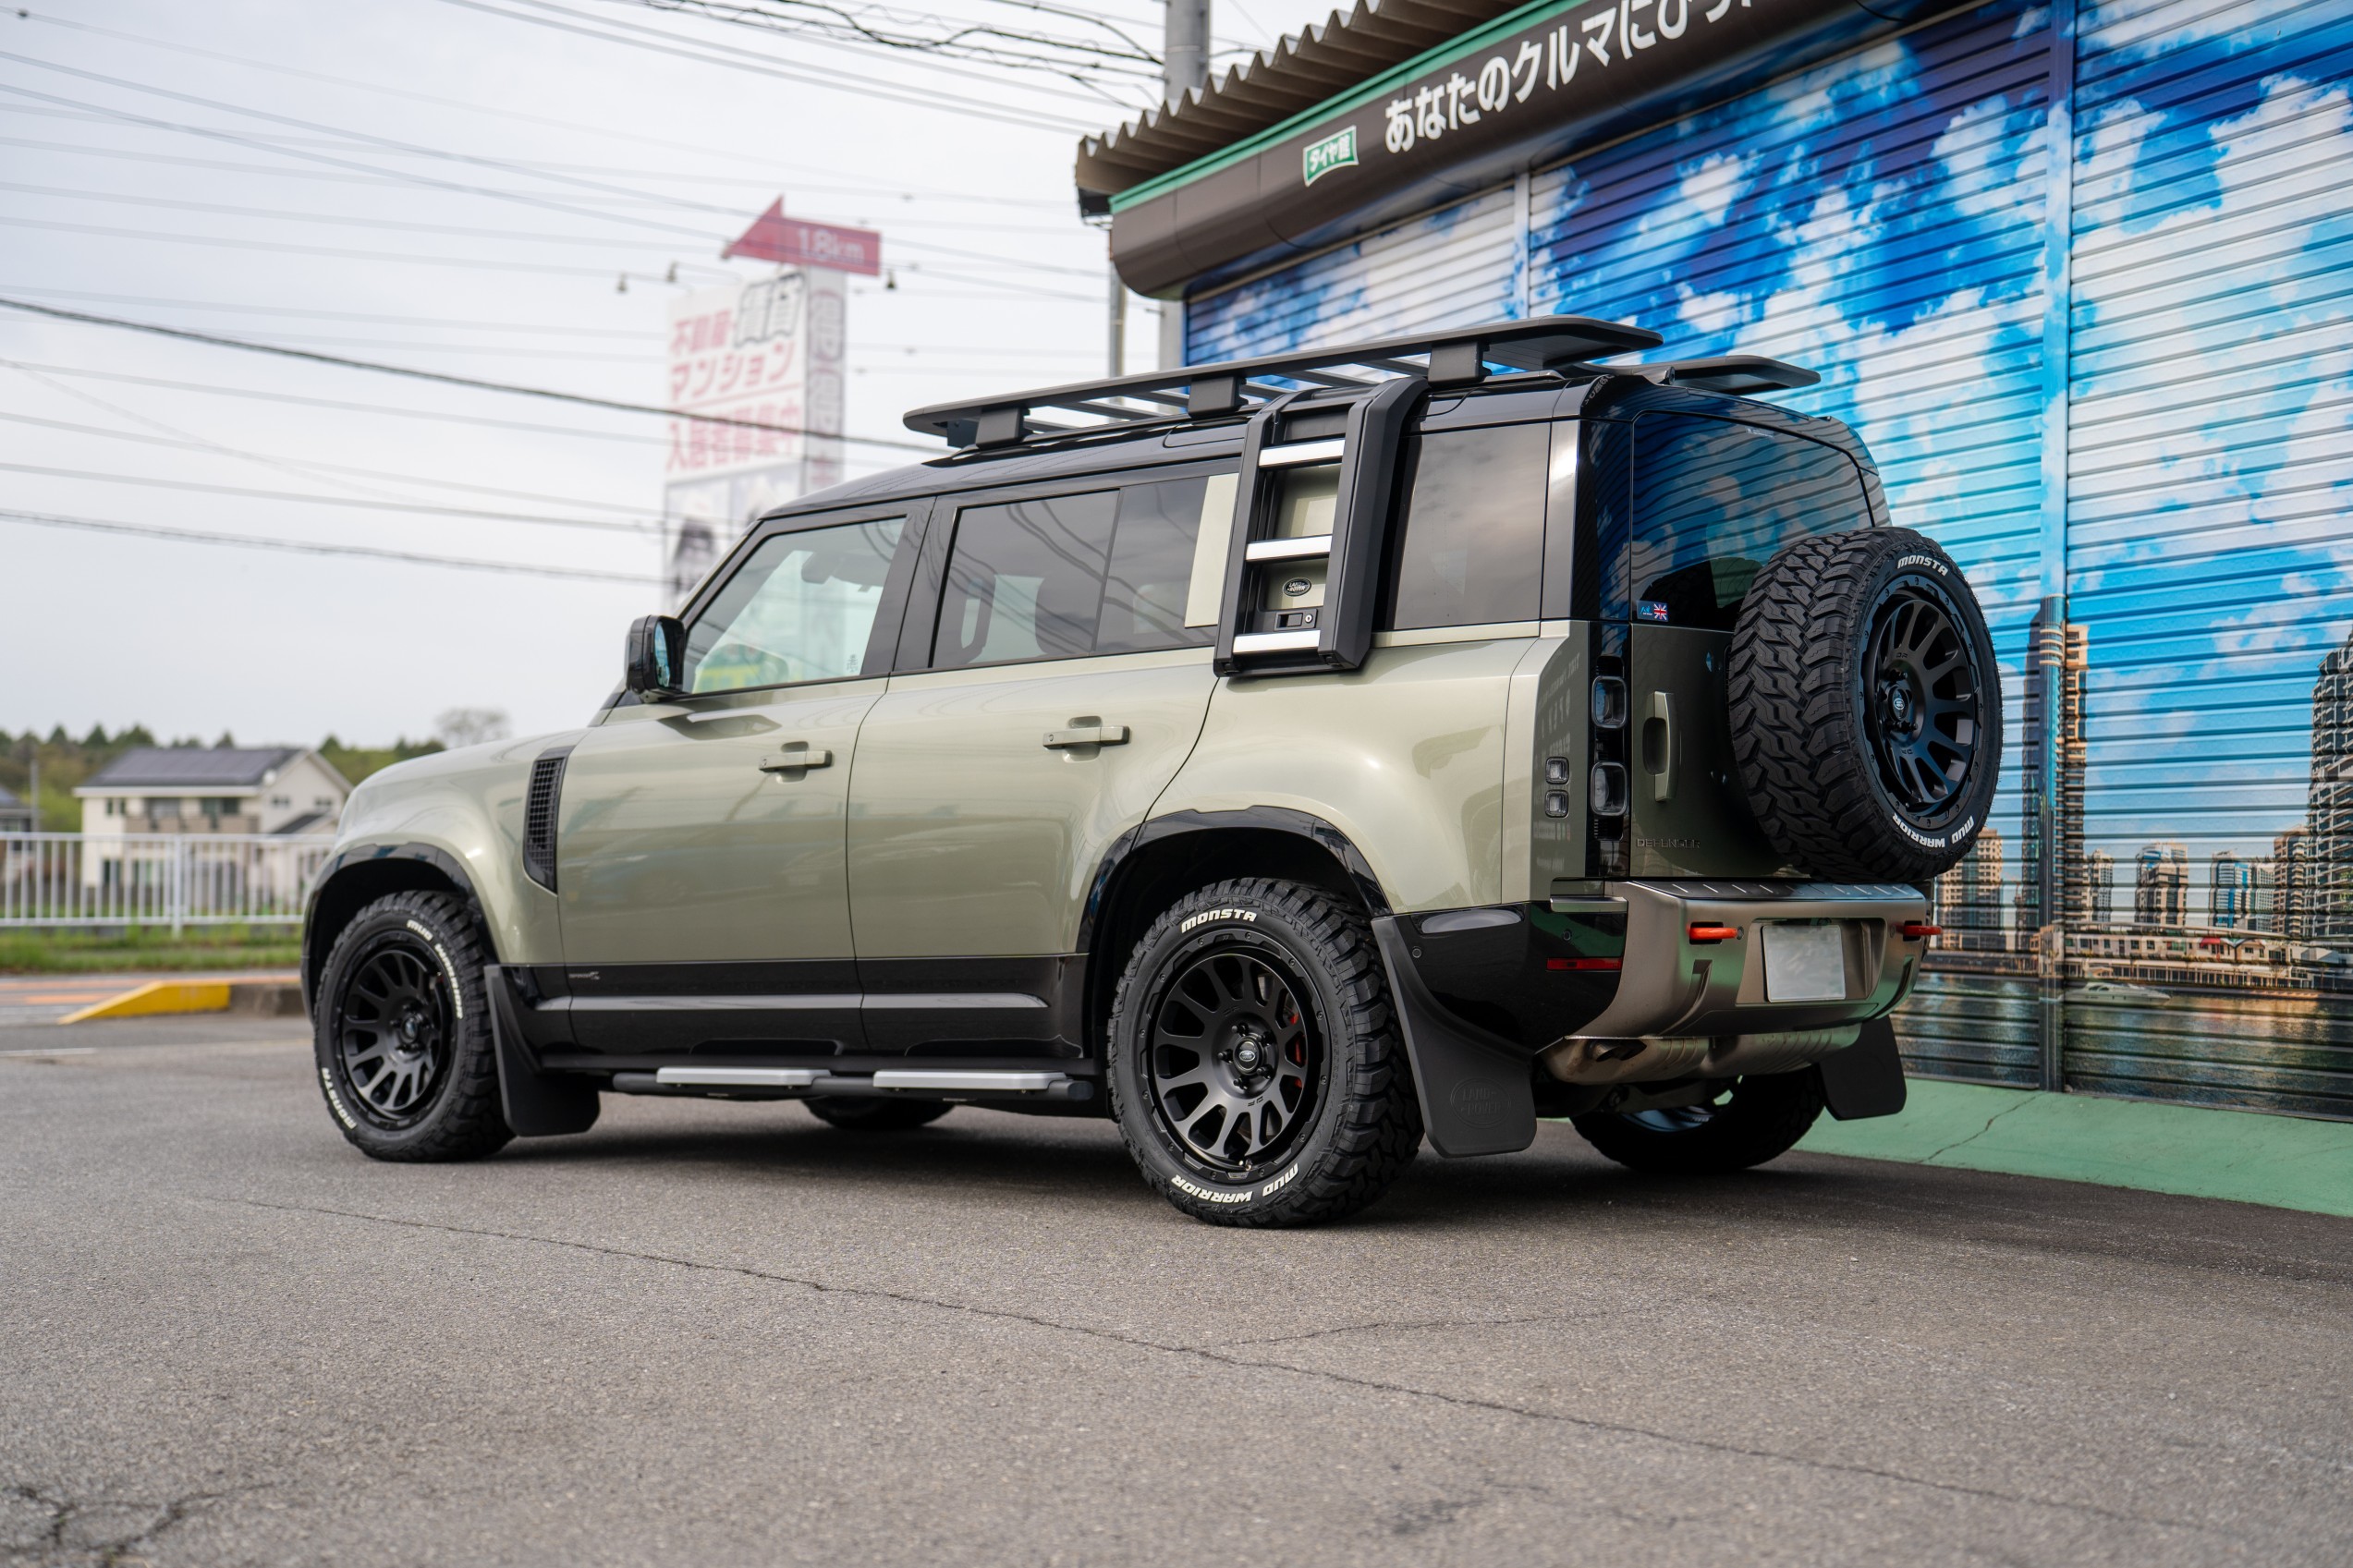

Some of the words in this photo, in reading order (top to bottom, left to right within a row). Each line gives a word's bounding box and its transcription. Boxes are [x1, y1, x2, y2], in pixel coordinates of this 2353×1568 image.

[1386, 0, 1751, 153] あなたのクルマに
[1310, 134, 1351, 173] タイヤ館
[1897, 554, 1949, 577] MONSTA
[1636, 838, 1701, 848] DEFENDER
[1893, 813, 1945, 848] WARRIOR
[1952, 815, 1975, 845] MUD
[1181, 909, 1257, 933] MONSTA
[407, 919, 433, 942] MUD
[434, 943, 463, 1019] WARRIOR
[322, 1067, 358, 1130] MONSTA
[1462, 1087, 1491, 1101] LAND
[1171, 1174, 1253, 1203] WARRIOR
[1262, 1162, 1298, 1197] MUD
